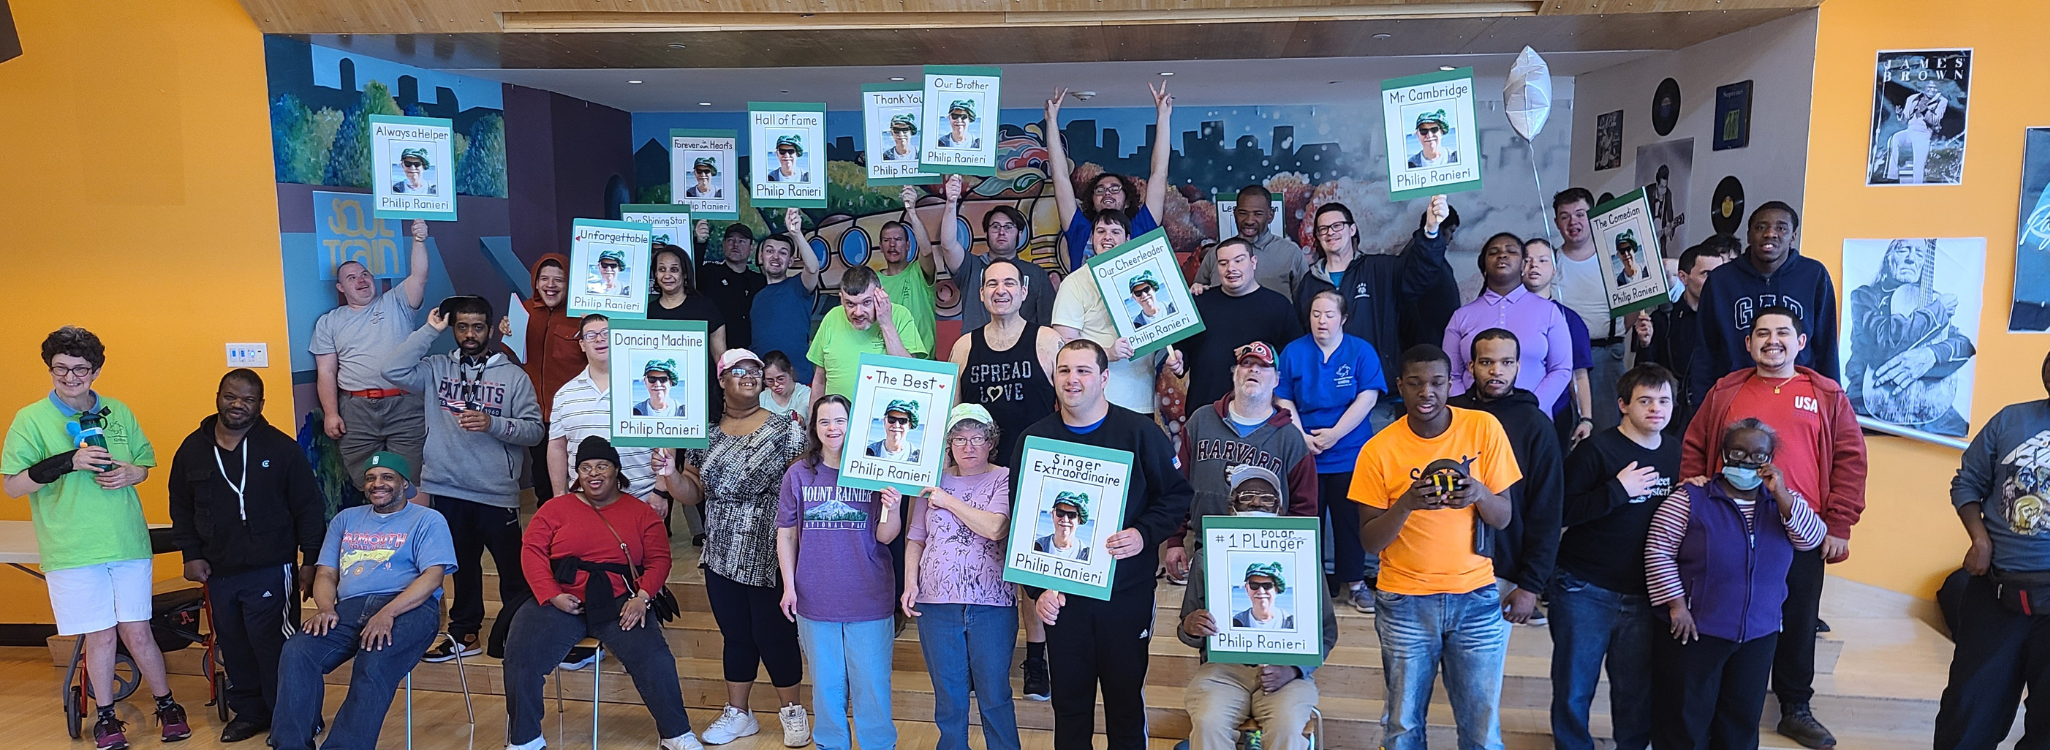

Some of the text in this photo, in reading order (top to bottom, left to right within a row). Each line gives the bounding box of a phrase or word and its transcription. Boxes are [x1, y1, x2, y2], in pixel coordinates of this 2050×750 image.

[1883, 57, 1965, 69] JAMES
[934, 78, 989, 90] Our Brother
[1883, 69, 1964, 82] BROWN
[873, 94, 905, 104] Thank
[1389, 83, 1468, 104] Mr Cambridge
[755, 113, 818, 126] Hall of Fame
[375, 126, 449, 141] Always a Helper
[674, 139, 699, 149] Forever
[709, 140, 733, 150] Hearts
[927, 151, 987, 165] Philip Ranieri
[873, 165, 899, 178] Philip
[1396, 168, 1471, 188] Philip Ranieri
[756, 183, 821, 199] Philip Ranieri
[382, 196, 449, 210] Philip Ranieri
[701, 200, 731, 210] Ranieri
[642, 214, 669, 226] Shining
[670, 216, 687, 225] Star
[1593, 207, 1641, 230] The Comedian
[580, 229, 649, 244] Unforgettable
[1098, 244, 1164, 278] Our Cheerleader
[1612, 282, 1659, 305] Philip Ranieri
[574, 296, 640, 311] Philip Ranieri
[1128, 313, 1190, 347] Philip Ranieri
[614, 332, 703, 349] Dancing Machine
[875, 370, 938, 390] The Best
[970, 360, 1032, 384] SPREAD
[1795, 395, 1818, 413] USA
[620, 420, 700, 437] Philip Ranieri
[1052, 453, 1102, 471] Singer
[1197, 438, 1283, 475] HARVARD
[849, 460, 932, 483] Philip Ranieri
[1034, 460, 1121, 487] Extraordinaire
[801, 486, 873, 503] MOUNT RAINIER
[1015, 552, 1103, 584] Philip Ranieri
[1218, 632, 1306, 652] Philip Ranieri
